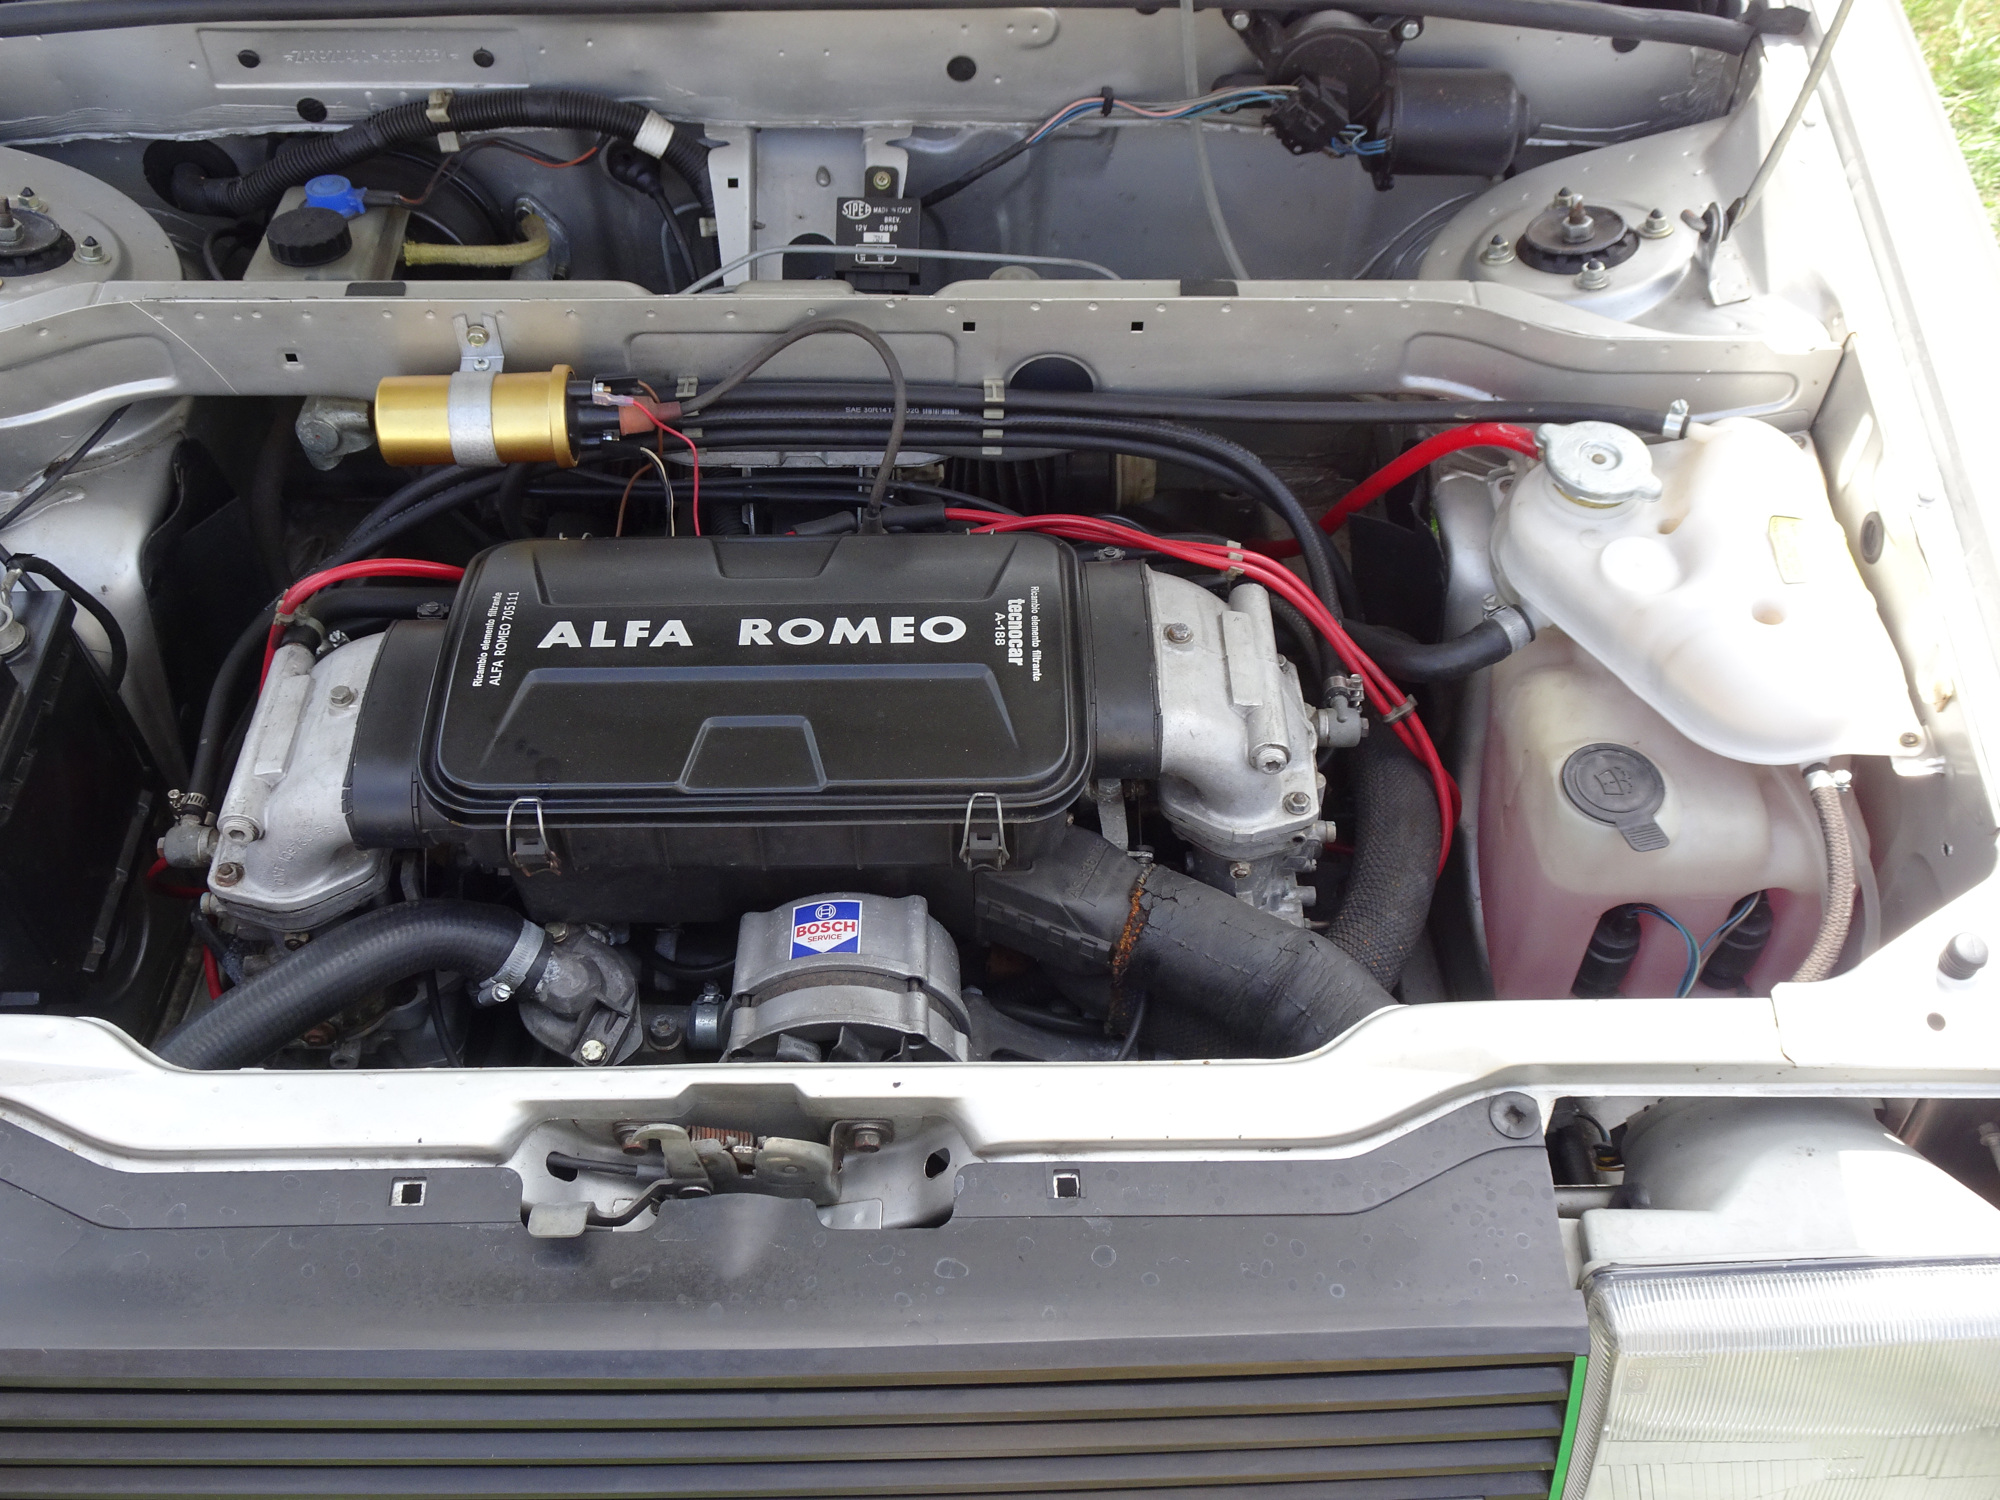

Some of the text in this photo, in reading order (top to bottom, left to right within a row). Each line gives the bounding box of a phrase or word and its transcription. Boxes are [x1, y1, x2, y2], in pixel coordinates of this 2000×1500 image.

[855, 224, 898, 232] 12V 0898
[472, 592, 503, 687] Ricambio elemento filtrante
[489, 591, 520, 686] ALFA ROMEO 705111
[537, 615, 967, 649] ALFA ROMEO
[994, 612, 1006, 646] A-188
[1007, 598, 1025, 666] tecnocar
[1030, 586, 1043, 682] Ricambio elemento filtrante
[796, 921, 856, 938] BOSCH
[807, 933, 842, 943] SERVICE
